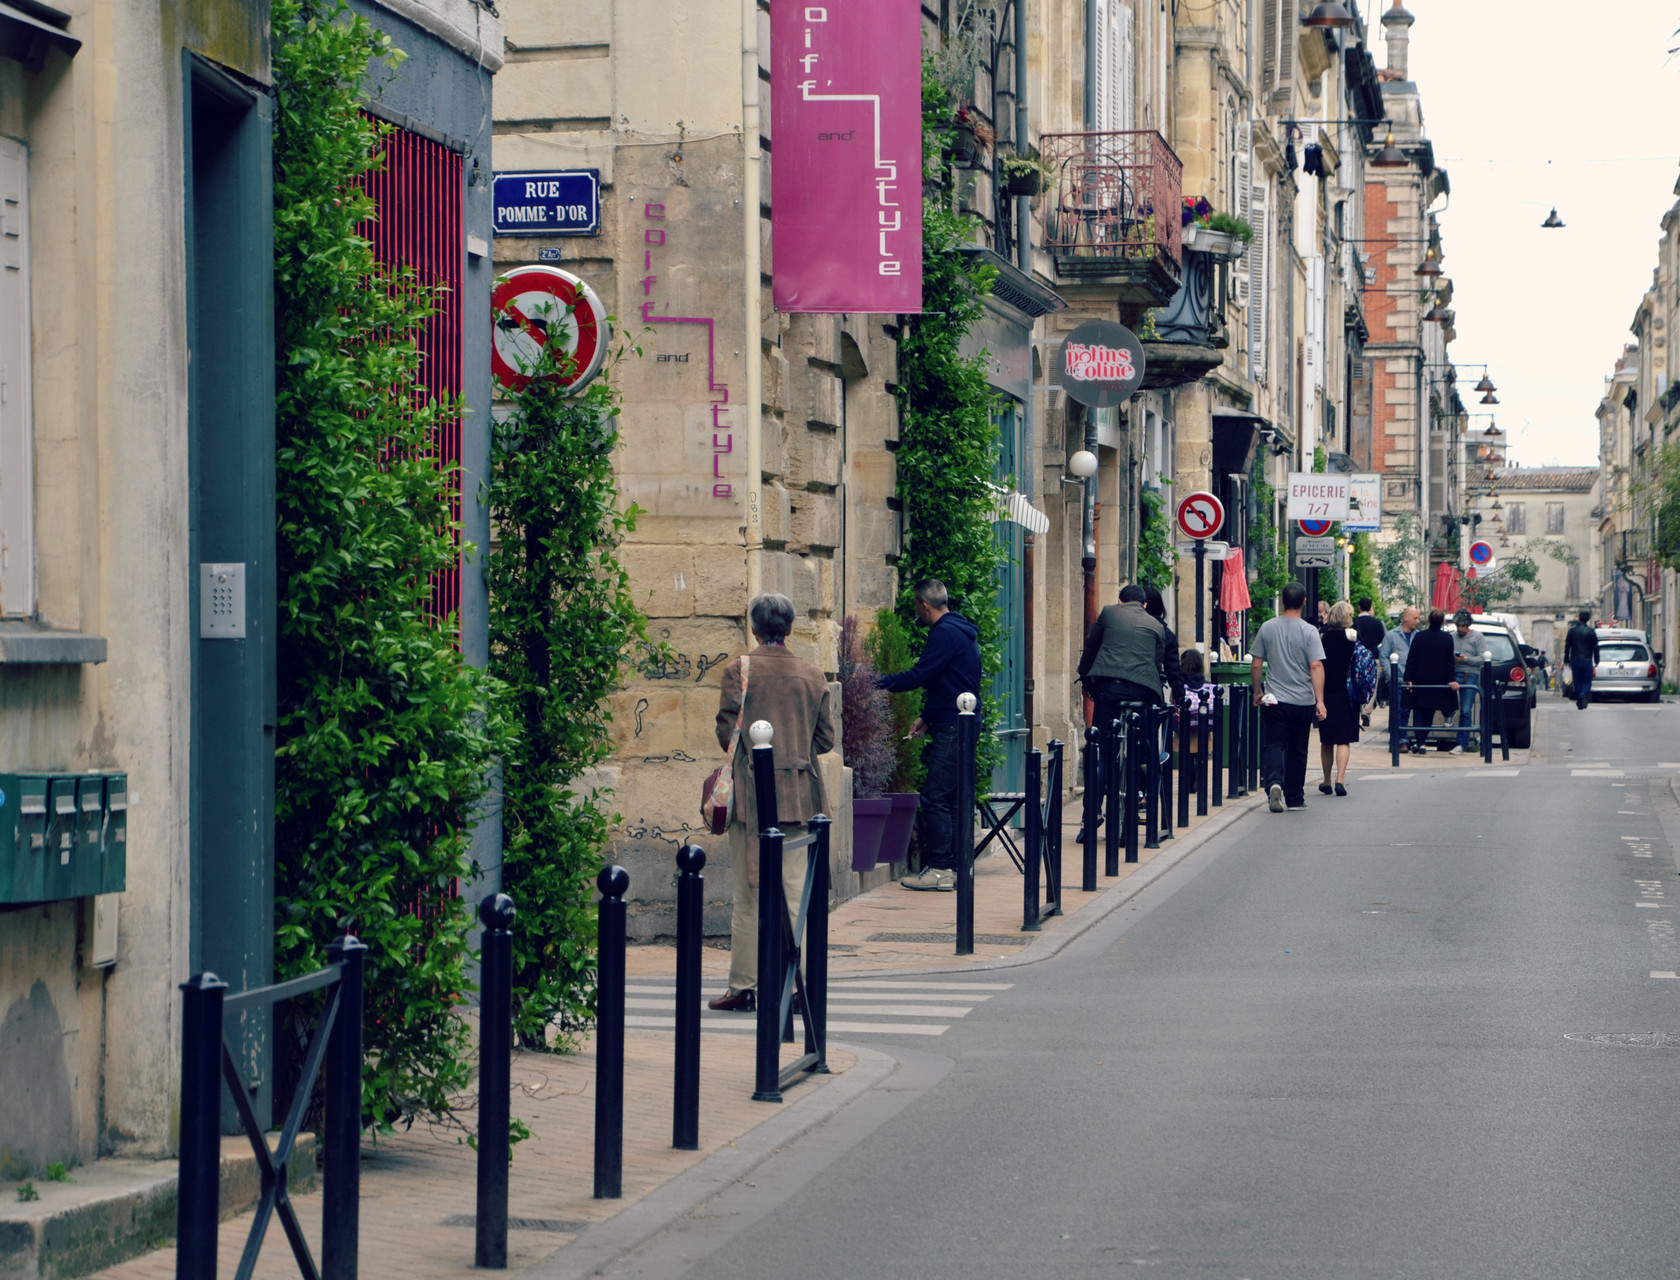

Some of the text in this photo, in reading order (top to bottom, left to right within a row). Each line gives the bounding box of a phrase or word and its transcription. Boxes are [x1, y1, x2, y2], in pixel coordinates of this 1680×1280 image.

[817, 130, 855, 141] and
[525, 181, 559, 198] RUE
[875, 160, 901, 276] style
[1068, 342, 1085, 350] les
[656, 352, 692, 363] and
[1066, 362, 1132, 378] de Coline
[710, 383, 733, 498] style
[1292, 485, 1346, 499] EPICERIE
[1308, 503, 1330, 516] 7/7
